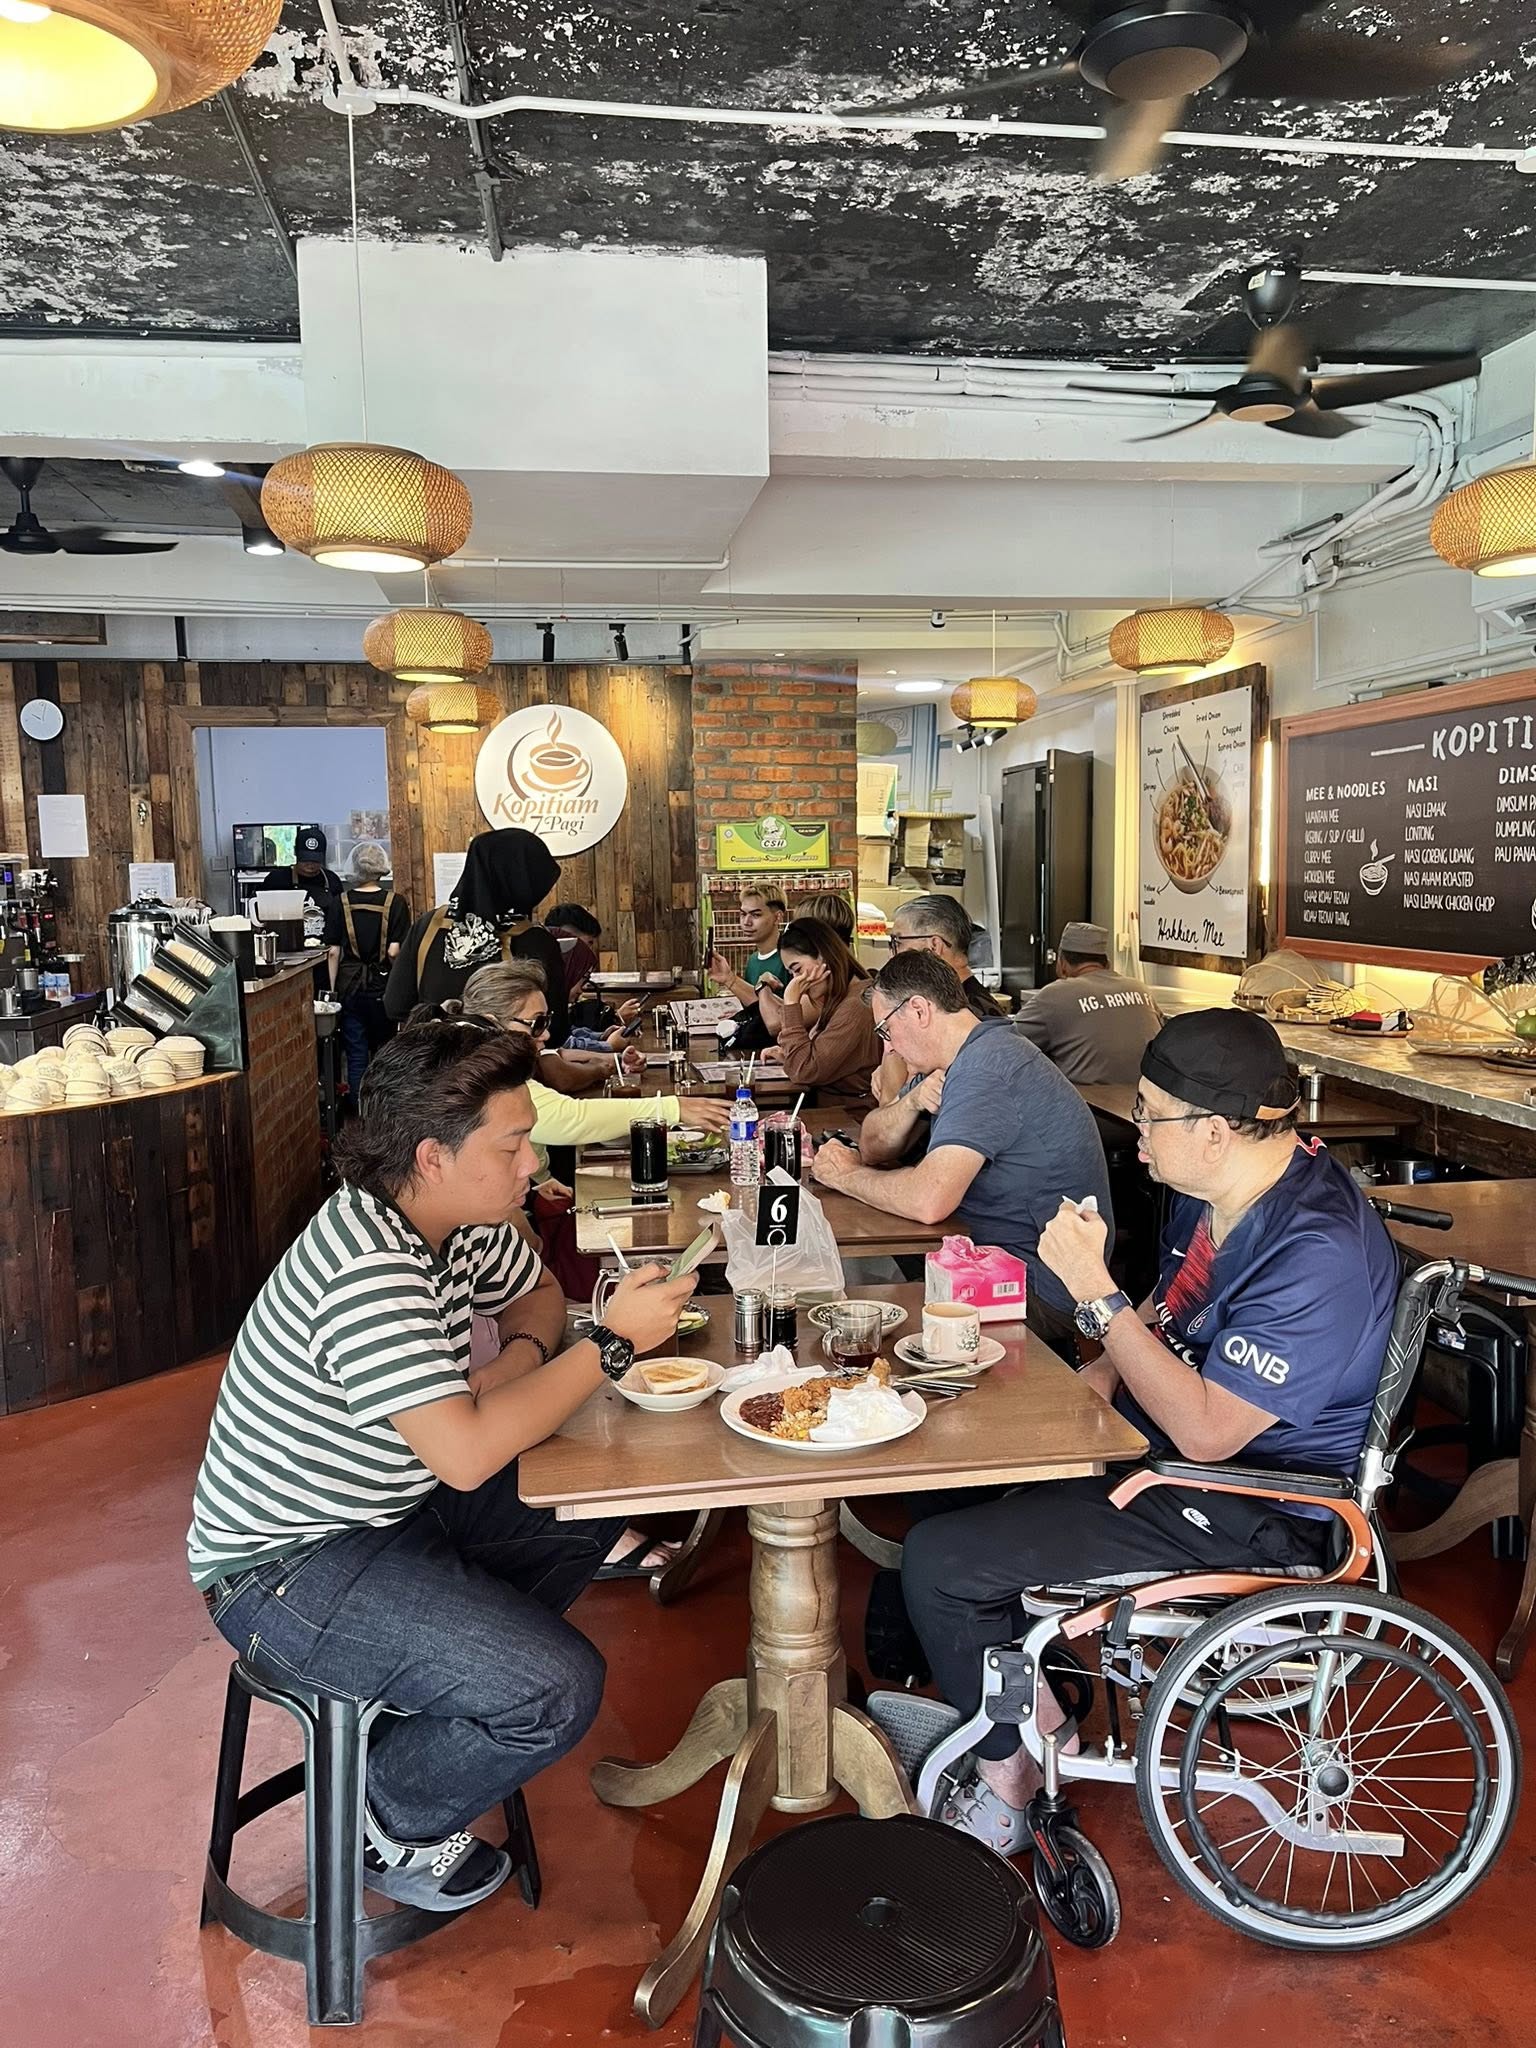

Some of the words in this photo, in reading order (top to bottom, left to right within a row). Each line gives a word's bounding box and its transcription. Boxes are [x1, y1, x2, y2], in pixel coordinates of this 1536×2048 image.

[1432, 715, 1534, 760] KOPITI
[1407, 775, 1438, 793] NASI
[1499, 764, 1536, 785] DIMS
[1306, 786, 1325, 801] MEE
[1327, 785, 1335, 800] &
[1336, 780, 1386, 799] NOODLES
[493, 793, 599, 823] Kopitiam
[1329, 808, 1340, 823] MEE
[1405, 803, 1421, 819] NASI
[1422, 801, 1447, 818] LEMAK
[530, 815, 543, 834] 7
[544, 815, 585, 836] Pagi
[1405, 825, 1434, 841] LONTONG
[1495, 819, 1535, 838] DUMPLING
[1321, 849, 1332, 864] MEE
[1404, 848, 1420, 864] NASI
[1421, 847, 1448, 864] GORENG
[1449, 847, 1475, 864] UDANG
[1494, 846, 1512, 863] PAU
[1325, 869, 1336, 884] MEE
[1403, 871, 1420, 886] NASI
[1421, 871, 1442, 886] AYAM
[1442, 871, 1474, 888] ROASTED
[1403, 893, 1419, 909] NASI
[1420, 893, 1444, 910] LEMAK
[1445, 894, 1474, 911] CHICKEN
[1474, 895, 1496, 912] CHOP
[1157, 917, 1199, 943] Hokkien
[1203, 918, 1225, 946] Mee
[1078, 996, 1104, 1013] KG.
[1104, 991, 1144, 1008] RAWA
[770, 1194, 788, 1223] 6
[1224, 1335, 1290, 1385] QNB
